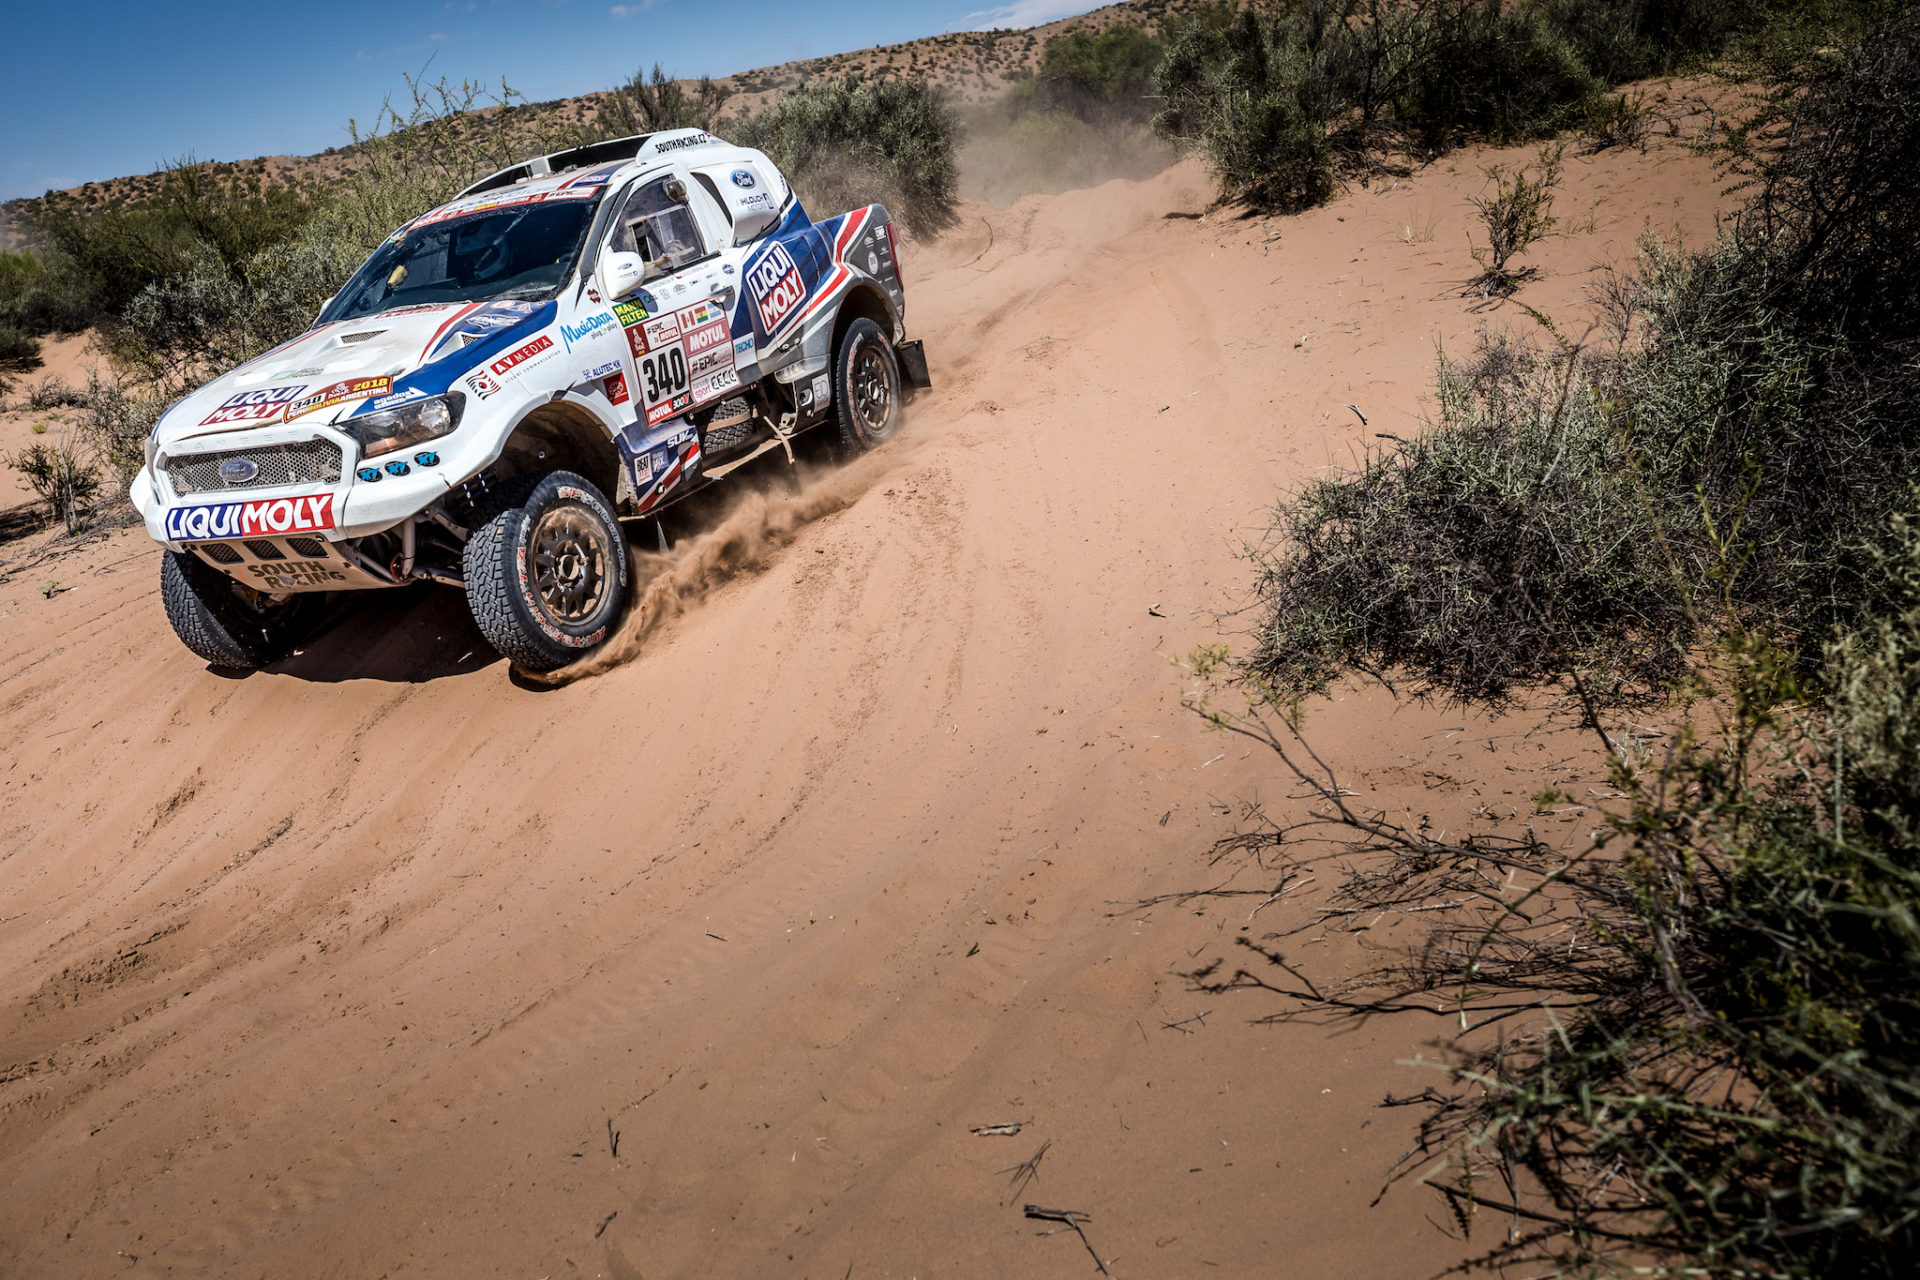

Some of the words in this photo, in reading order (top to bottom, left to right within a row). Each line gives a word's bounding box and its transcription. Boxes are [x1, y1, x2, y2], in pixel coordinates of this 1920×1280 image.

[734, 171, 755, 187] Ford
[752, 246, 791, 298] LIQUI
[614, 300, 643, 317] MANN
[761, 270, 803, 328] MOLY
[621, 308, 648, 325] FILTER
[689, 324, 726, 352] MOTUL
[352, 378, 388, 391] 2018
[642, 347, 686, 403] 340
[224, 386, 304, 408] LIQUI
[293, 396, 322, 410] 340
[307, 397, 341, 412] BOLIVIA
[340, 387, 388, 402] ARGENTINA
[672, 392, 690, 410] 300V
[202, 402, 286, 424] MOLY
[648, 402, 672, 422] MOTUL
[168, 504, 244, 539] LIQUI
[242, 494, 333, 532] MOLY
[248, 560, 326, 578] SOUTH
